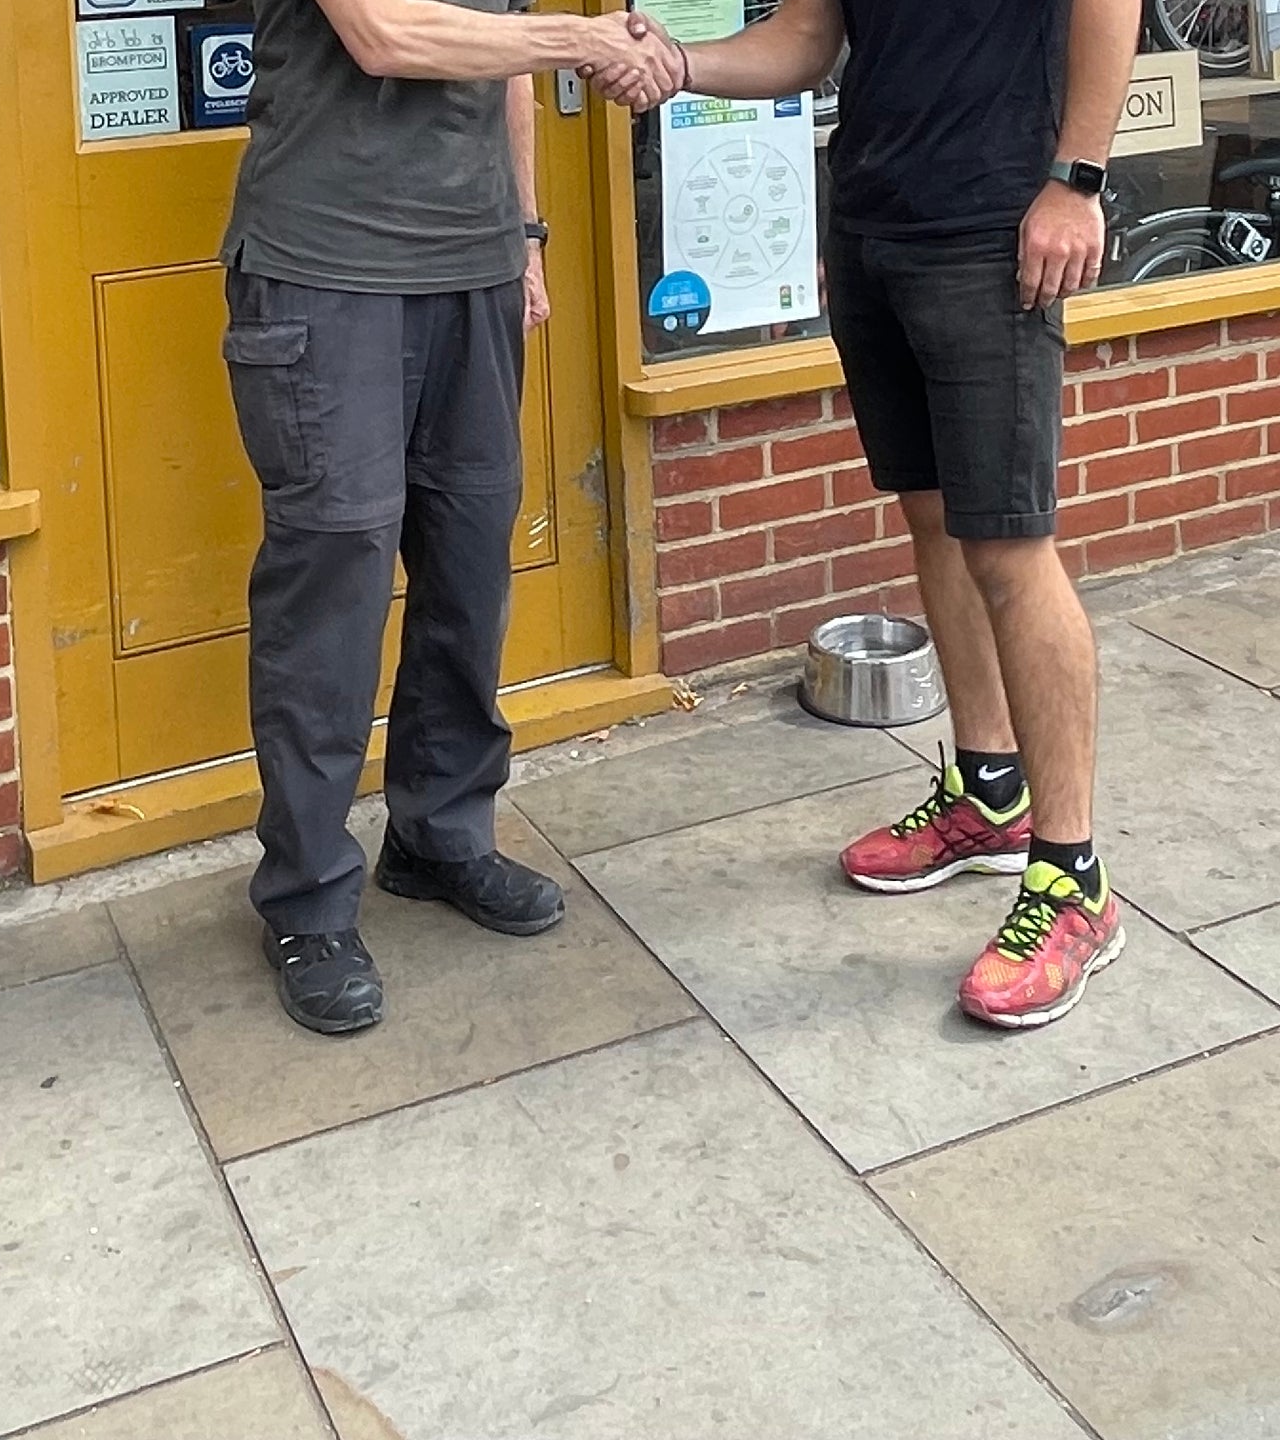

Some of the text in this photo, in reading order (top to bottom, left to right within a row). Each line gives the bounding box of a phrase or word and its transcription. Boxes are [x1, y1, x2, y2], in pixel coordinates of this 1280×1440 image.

[91, 52, 162, 71] BROMPTON
[89, 87, 169, 105] APPROVED
[90, 108, 169, 129] DEALER
